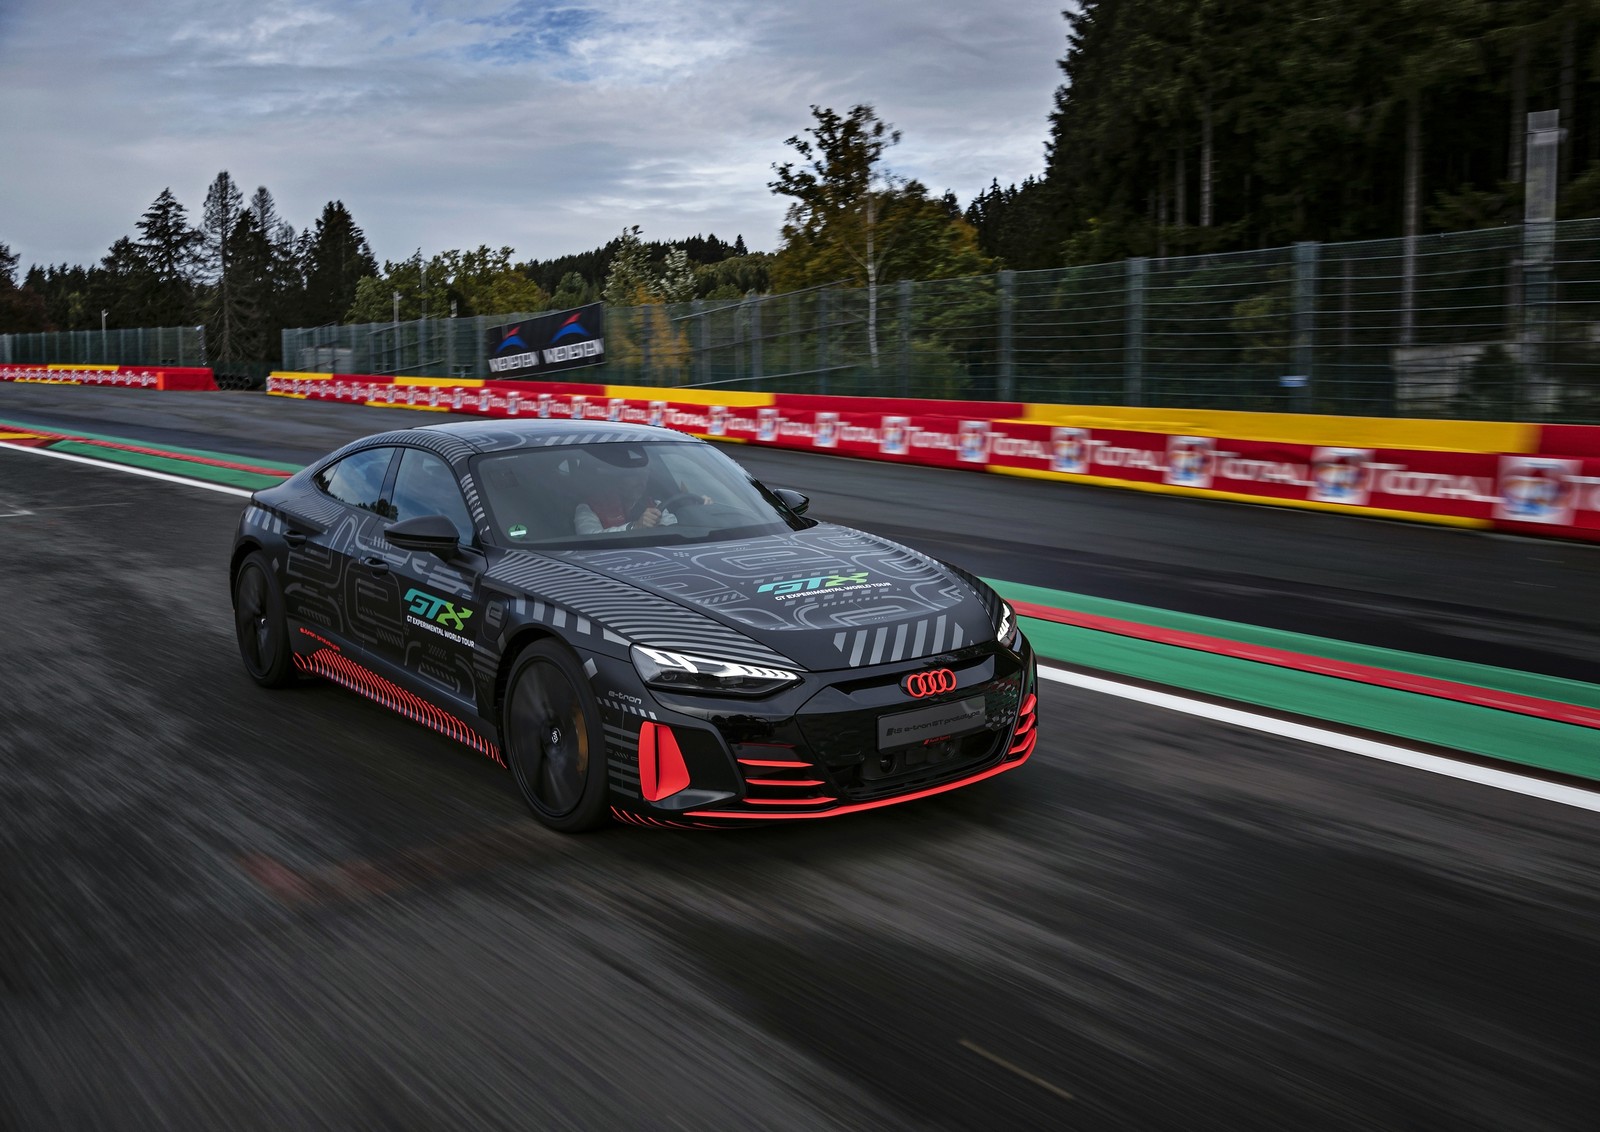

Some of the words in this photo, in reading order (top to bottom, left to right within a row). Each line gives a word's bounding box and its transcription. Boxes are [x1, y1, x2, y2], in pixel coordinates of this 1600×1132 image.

[904, 426, 961, 451] TOTAL
[985, 432, 1054, 460] TOTAL
[1083, 439, 1170, 472] TOTAL
[1206, 450, 1316, 487] TOTAL
[1362, 461, 1505, 503] TOTAL
[757, 572, 869, 595] GTX
[787, 587, 844, 599] EXPERIMENTAL
[844, 584, 871, 592] WORLD
[404, 588, 473, 631] GTX
[413, 618, 444, 637] EXPERIMENTAL
[444, 630, 461, 643] WORLD
[461, 637, 475, 648] TOUR
[608, 690, 642, 705] e-tron
[904, 723, 932, 732] e-tron
[944, 710, 981, 724] prototype
